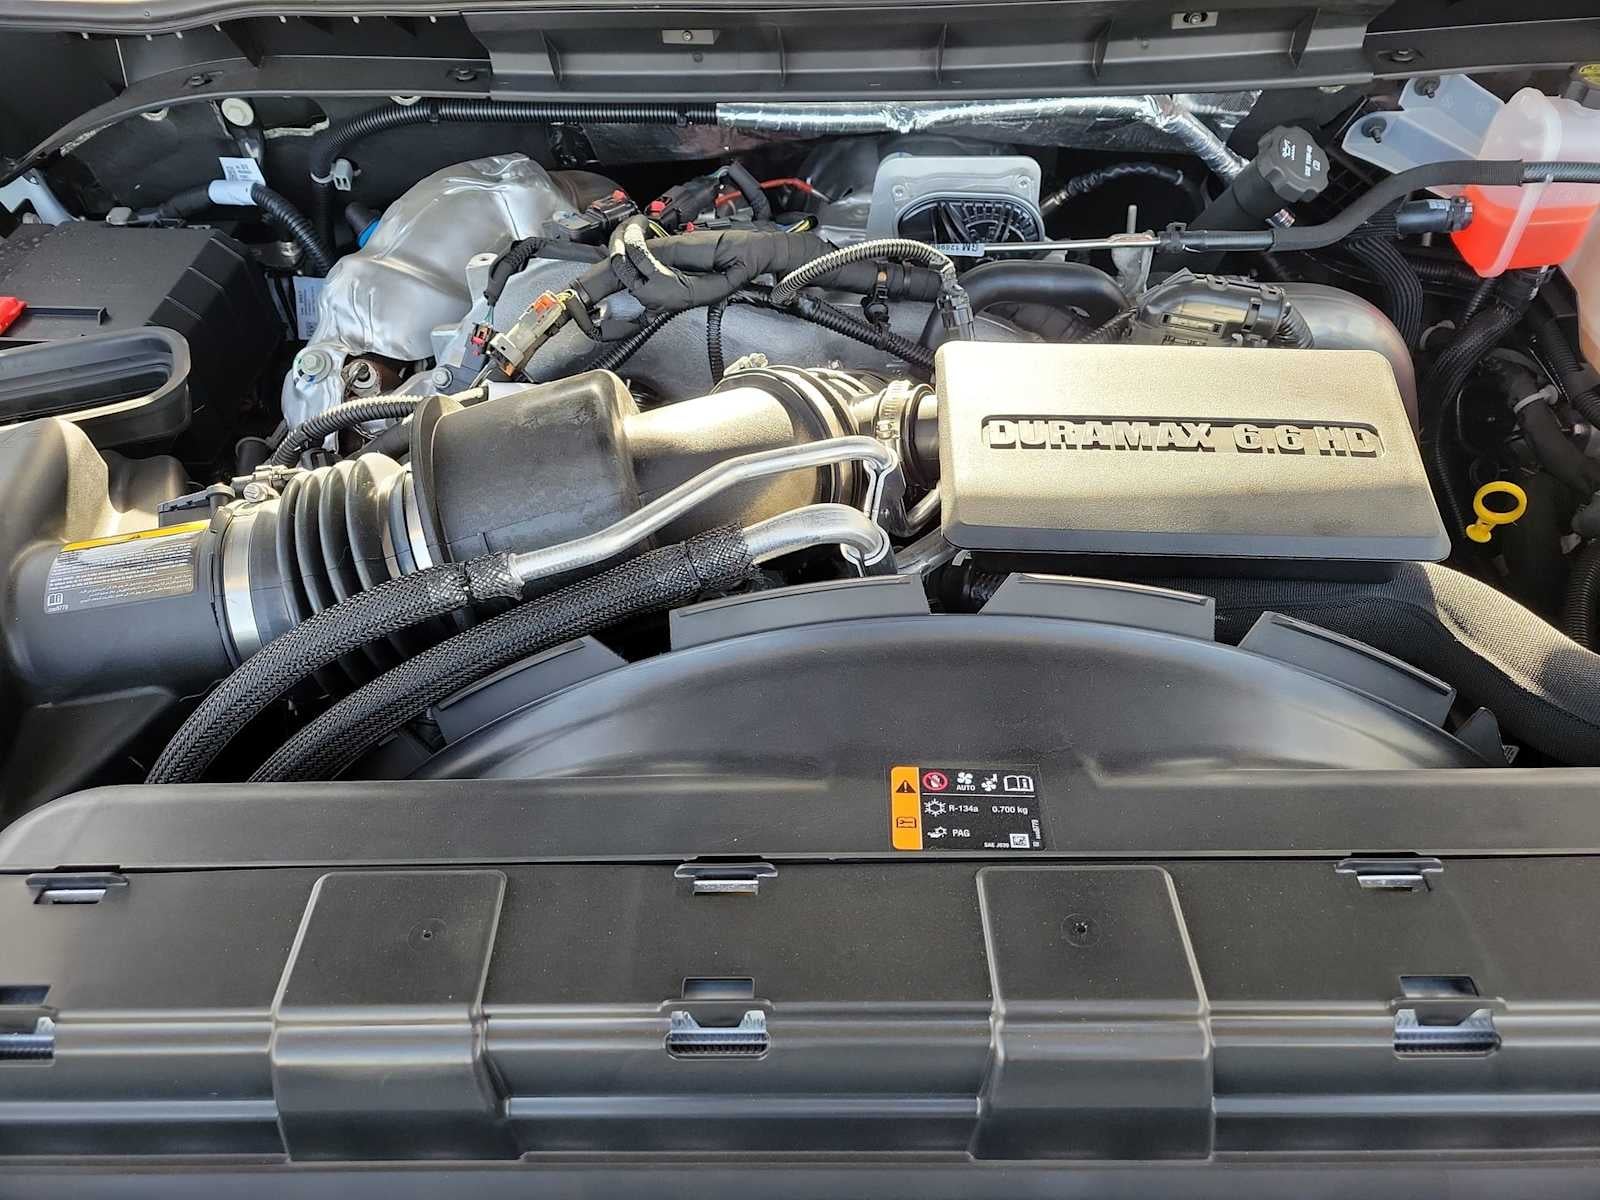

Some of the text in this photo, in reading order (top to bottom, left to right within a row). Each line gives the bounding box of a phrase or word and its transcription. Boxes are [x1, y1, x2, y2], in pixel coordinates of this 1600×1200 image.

[986, 419, 1378, 458] DURAMAX 6.6 HD
[948, 805, 1028, 815] R-134a 0.700 kg
[952, 829, 971, 837] PAG
